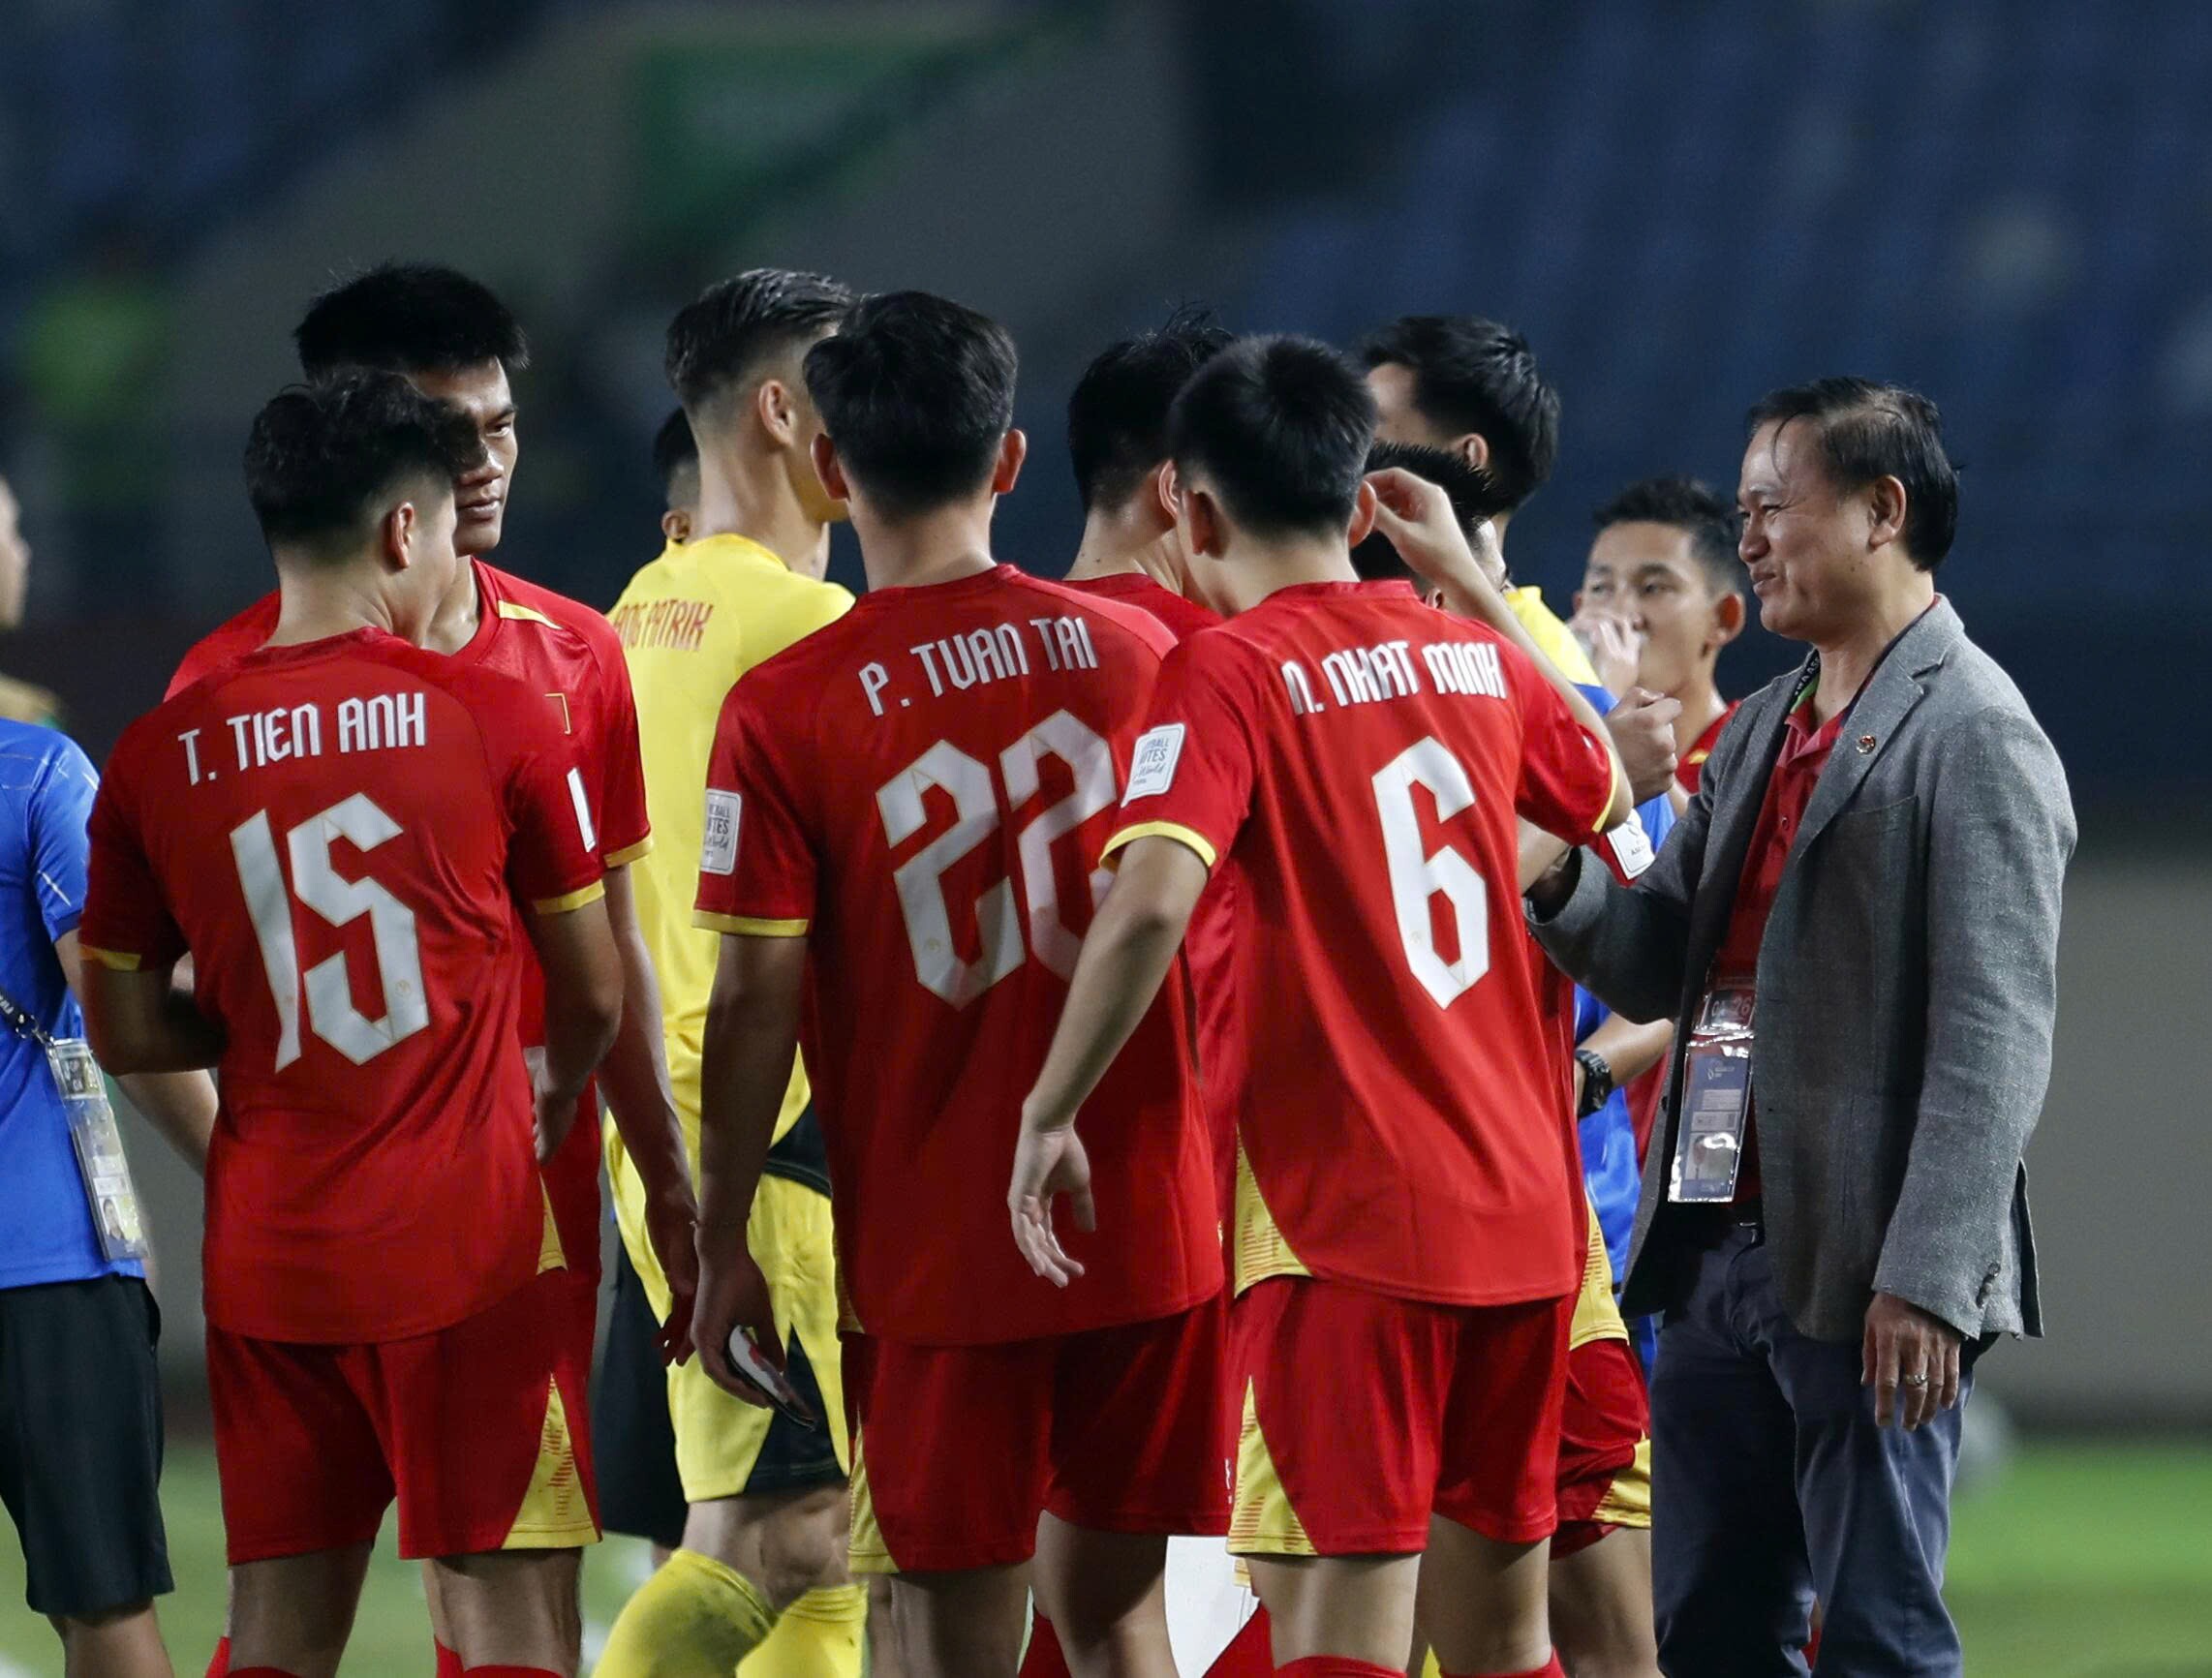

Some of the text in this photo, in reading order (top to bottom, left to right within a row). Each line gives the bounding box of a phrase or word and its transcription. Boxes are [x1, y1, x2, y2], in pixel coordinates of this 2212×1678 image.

[178, 692, 426, 786] T. TIEN ANH
[858, 616, 1099, 717] P. TUAN TAI
[1281, 640, 1507, 716] N. NHAT MINH
[230, 792, 429, 1074] 15
[876, 709, 1117, 1011] 22
[1371, 736, 1490, 1010] 6
